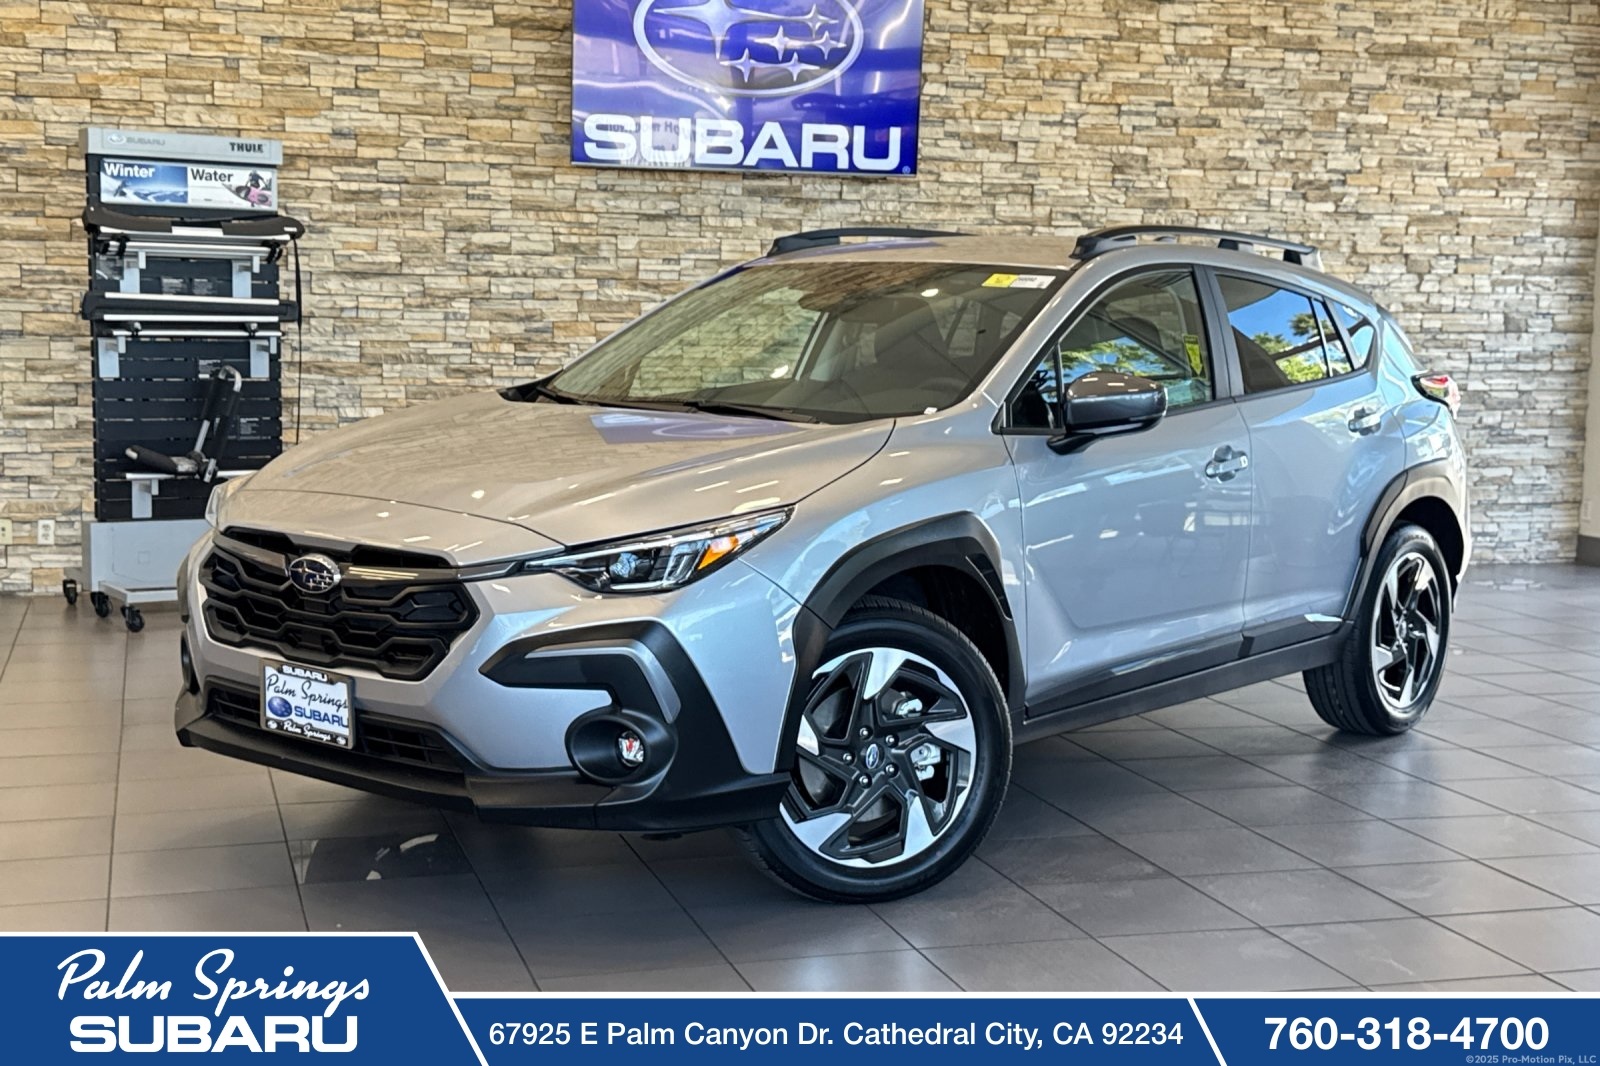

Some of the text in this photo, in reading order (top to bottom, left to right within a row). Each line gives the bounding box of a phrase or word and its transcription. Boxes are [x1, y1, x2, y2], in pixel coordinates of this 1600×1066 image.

[229, 142, 264, 153] THULE
[583, 113, 902, 171] SUBARU
[103, 162, 156, 179] Winter
[191, 168, 234, 183] Water
[282, 664, 328, 682] SUBARU
[266, 673, 349, 713] Palm Springs
[294, 705, 349, 729] SUBARU
[283, 720, 331, 742] Palm Springs
